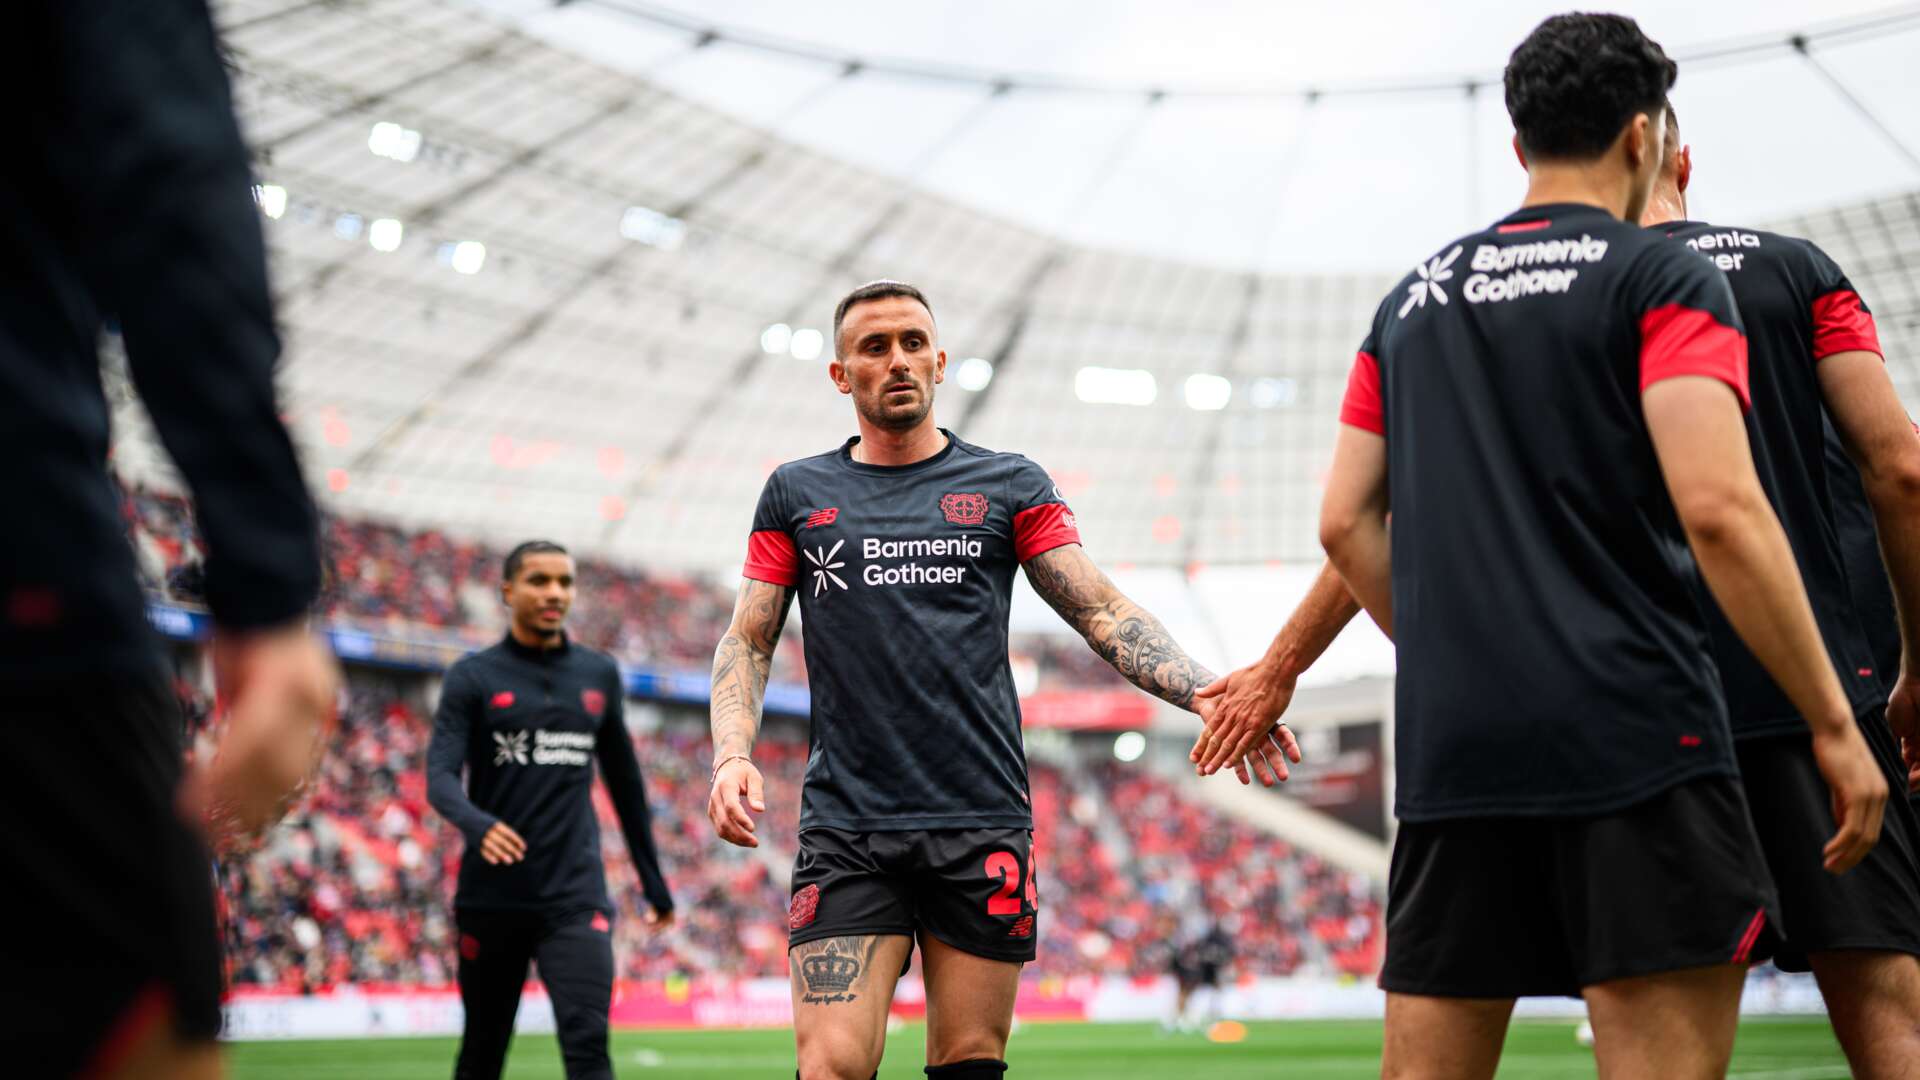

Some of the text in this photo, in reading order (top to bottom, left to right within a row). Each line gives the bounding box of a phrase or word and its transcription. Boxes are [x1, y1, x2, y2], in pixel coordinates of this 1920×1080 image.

[1470, 233, 1608, 272] Barmenia
[1685, 230, 1761, 253] enia
[1462, 267, 1579, 303] Gothaer
[863, 534, 982, 559] Barmenia
[863, 562, 966, 586] Gothaer
